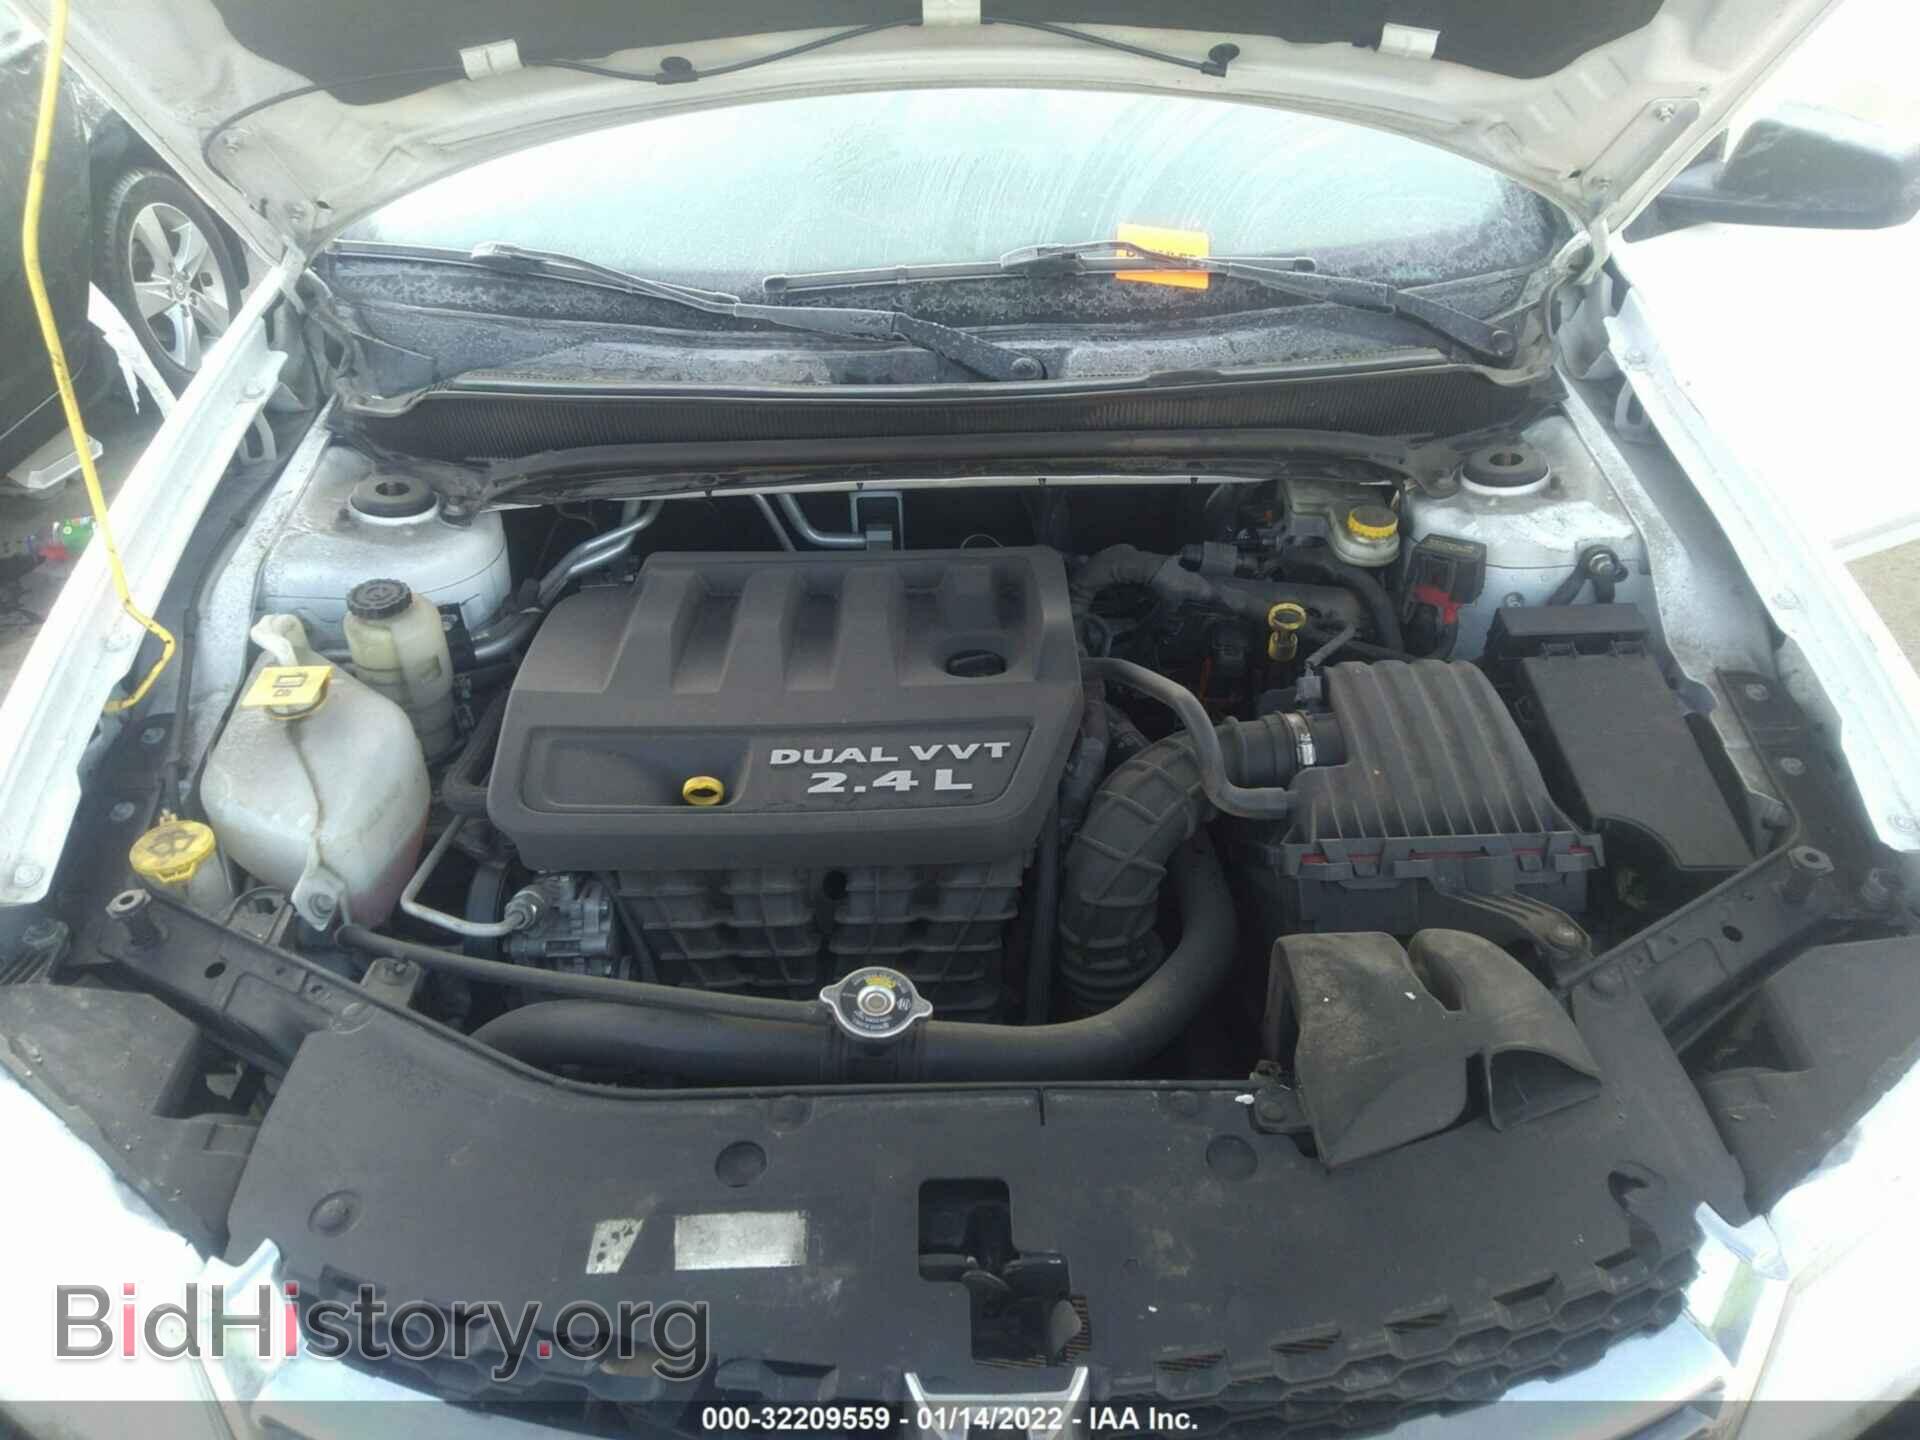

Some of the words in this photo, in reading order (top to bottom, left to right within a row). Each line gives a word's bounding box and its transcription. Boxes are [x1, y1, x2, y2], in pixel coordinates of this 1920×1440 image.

[769, 747, 898, 764] DUAL
[909, 742, 1011, 760] VVT
[807, 770, 919, 793] 2.4
[934, 769, 973, 790] L
